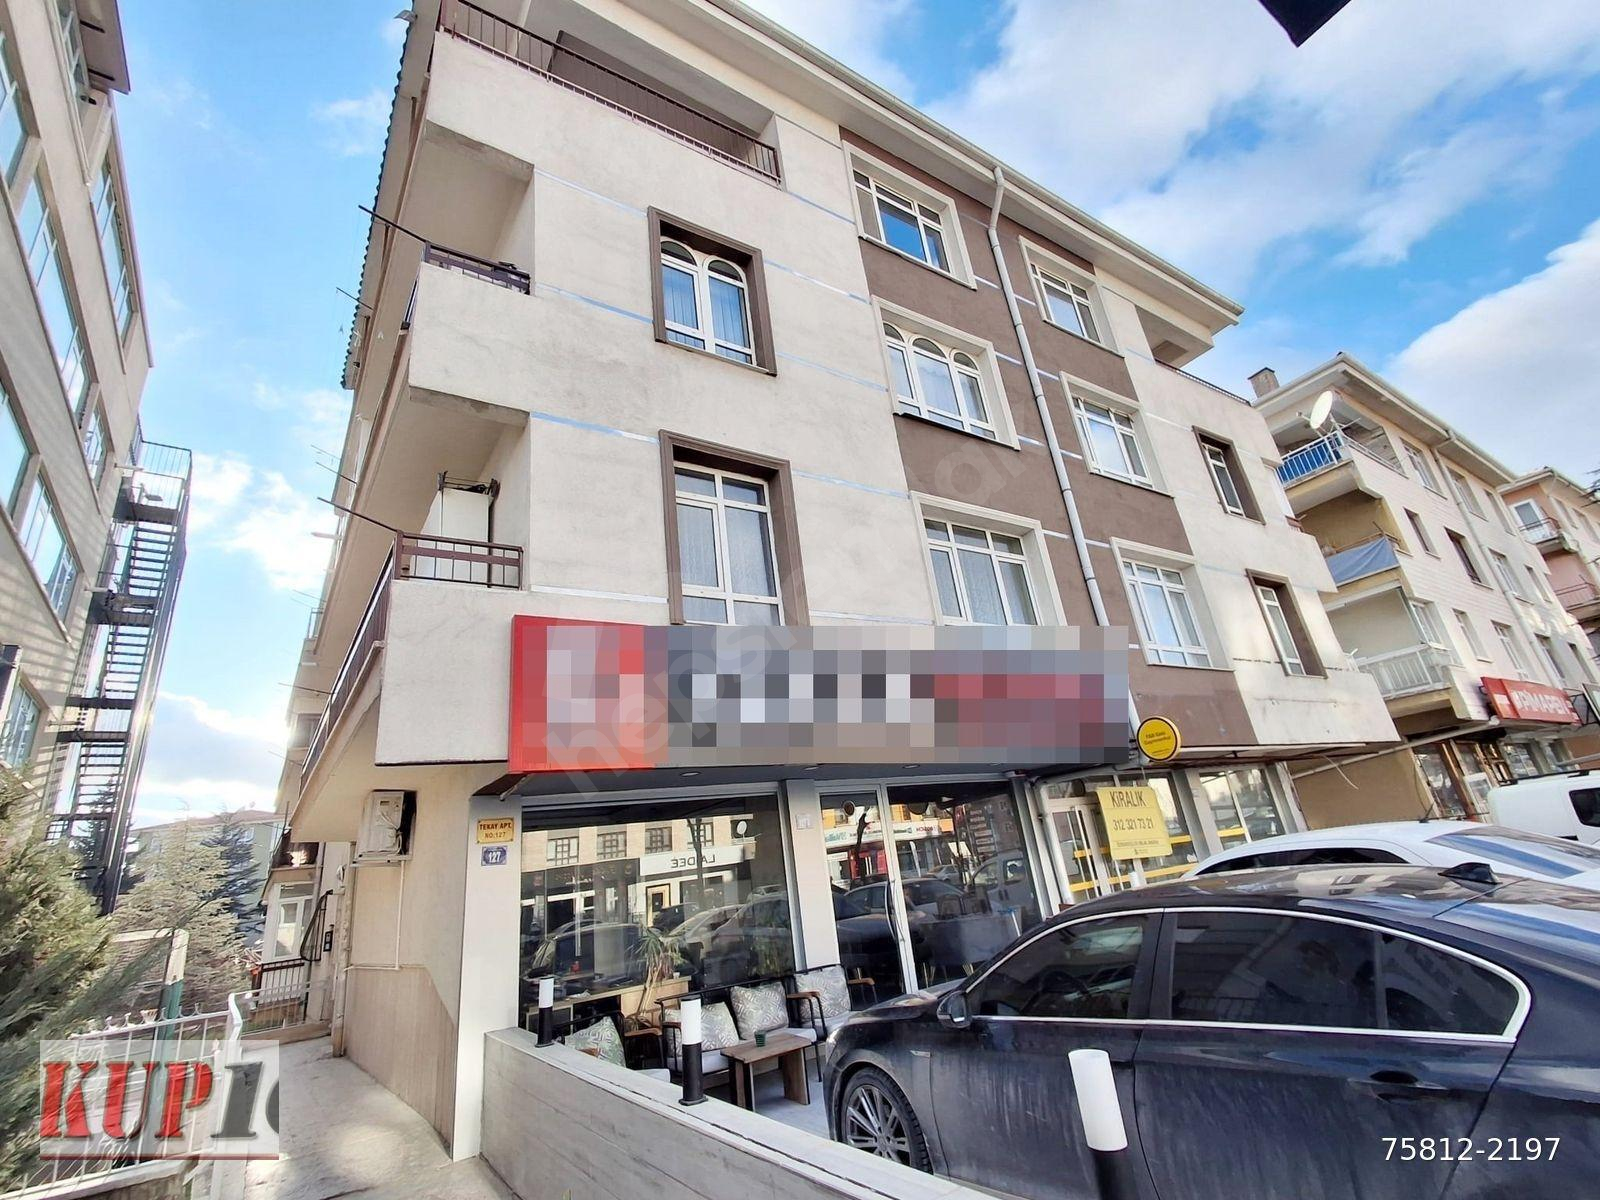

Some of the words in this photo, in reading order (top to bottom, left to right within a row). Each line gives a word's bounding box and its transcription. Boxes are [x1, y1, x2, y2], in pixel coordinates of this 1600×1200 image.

[1113, 819, 1125, 830] 312
[1126, 818, 1136, 830] 321
[1137, 818, 1146, 829] 73
[488, 852, 501, 862] 127
